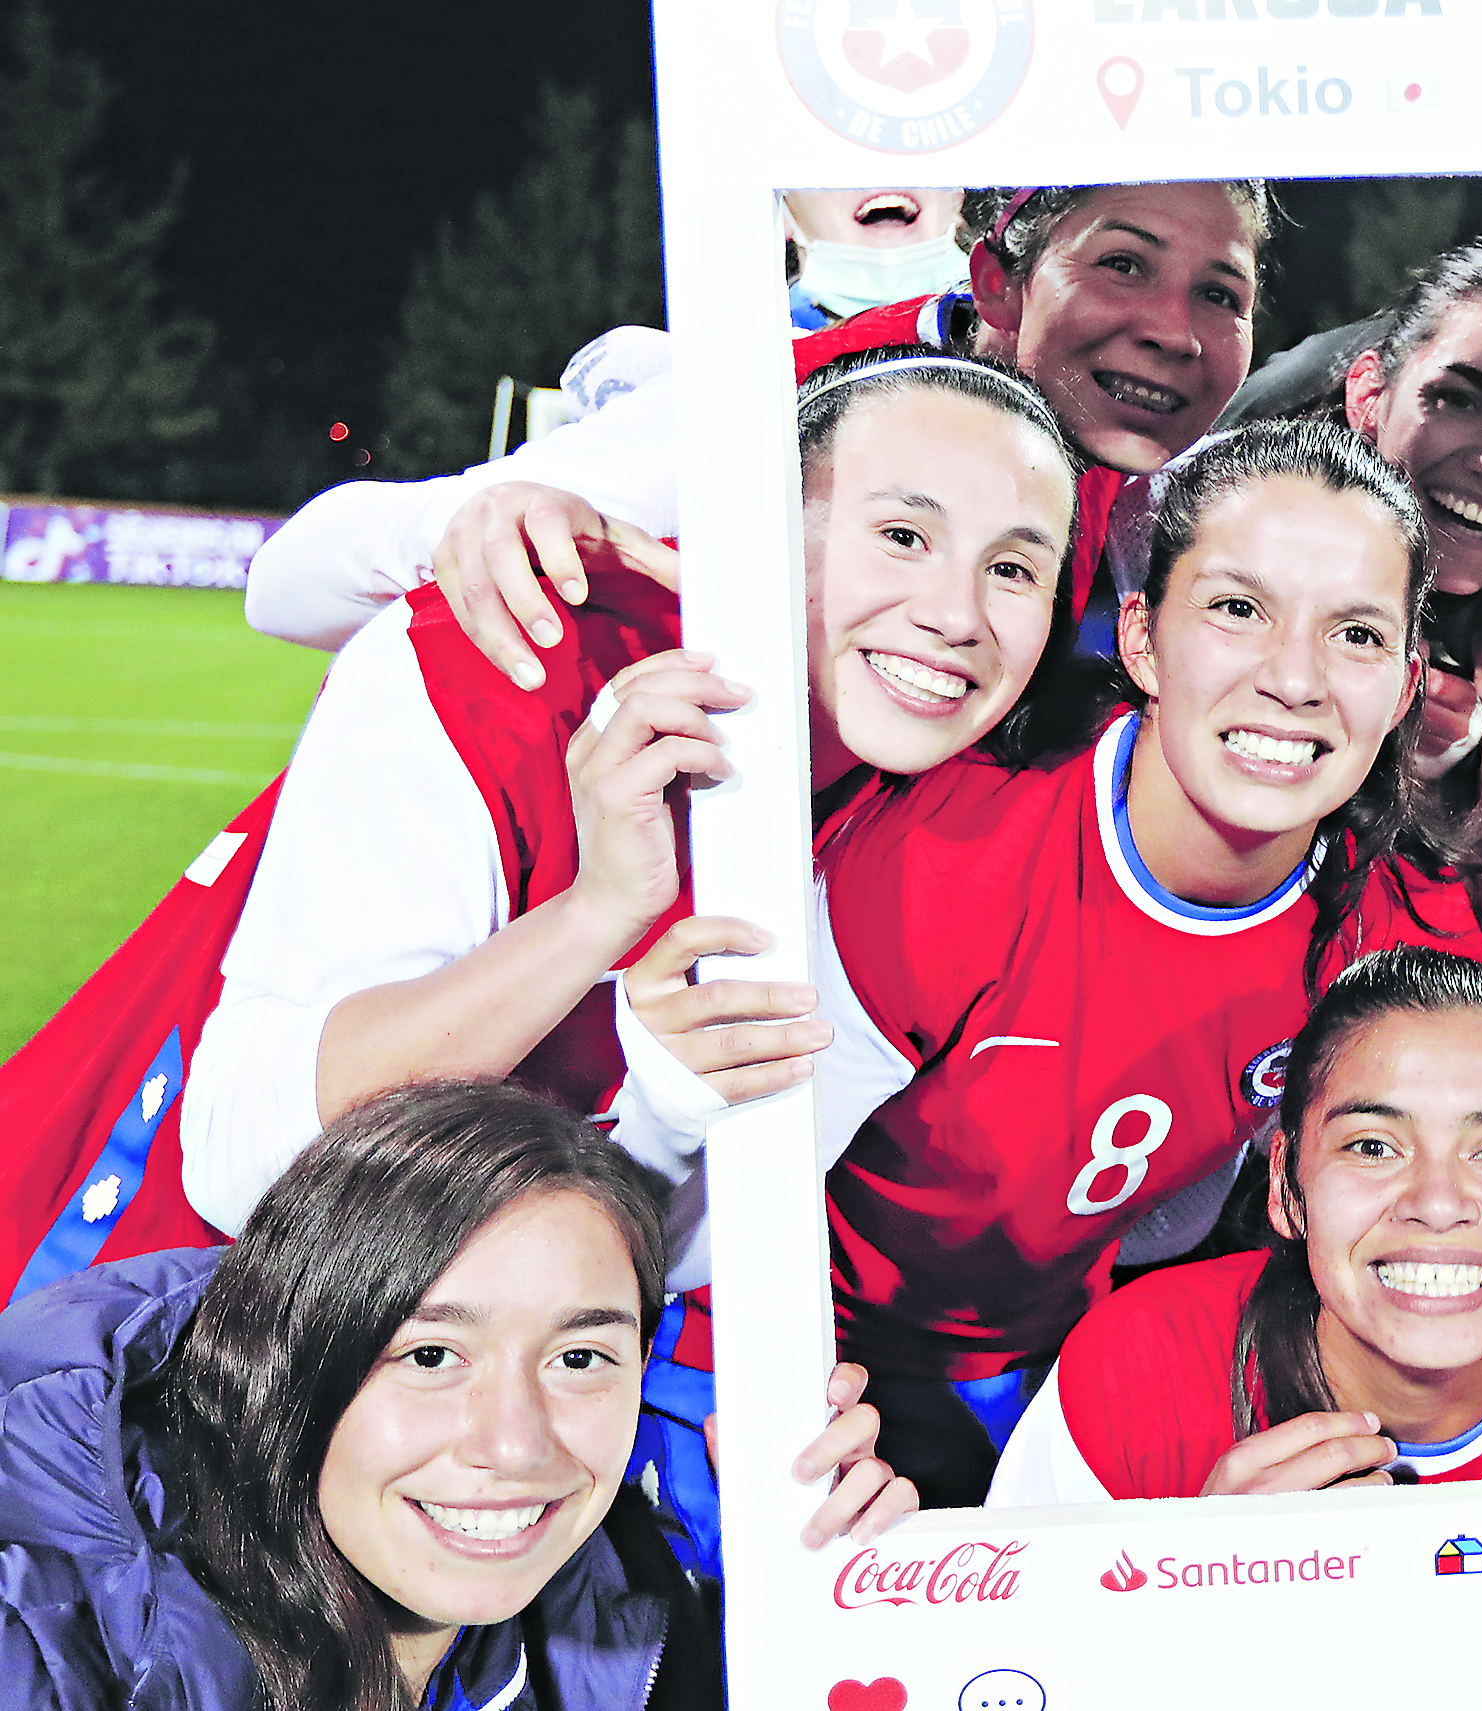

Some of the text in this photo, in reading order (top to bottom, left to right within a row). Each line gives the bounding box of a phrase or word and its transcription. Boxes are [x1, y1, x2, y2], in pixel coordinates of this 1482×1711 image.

[1175, 65, 1354, 119] Tokio
[847, 104, 977, 148] DE CHILE
[1066, 1093, 1173, 1215] 8
[833, 1539, 1032, 1610] Coca-Cola
[1157, 1549, 1361, 1588] Santander
